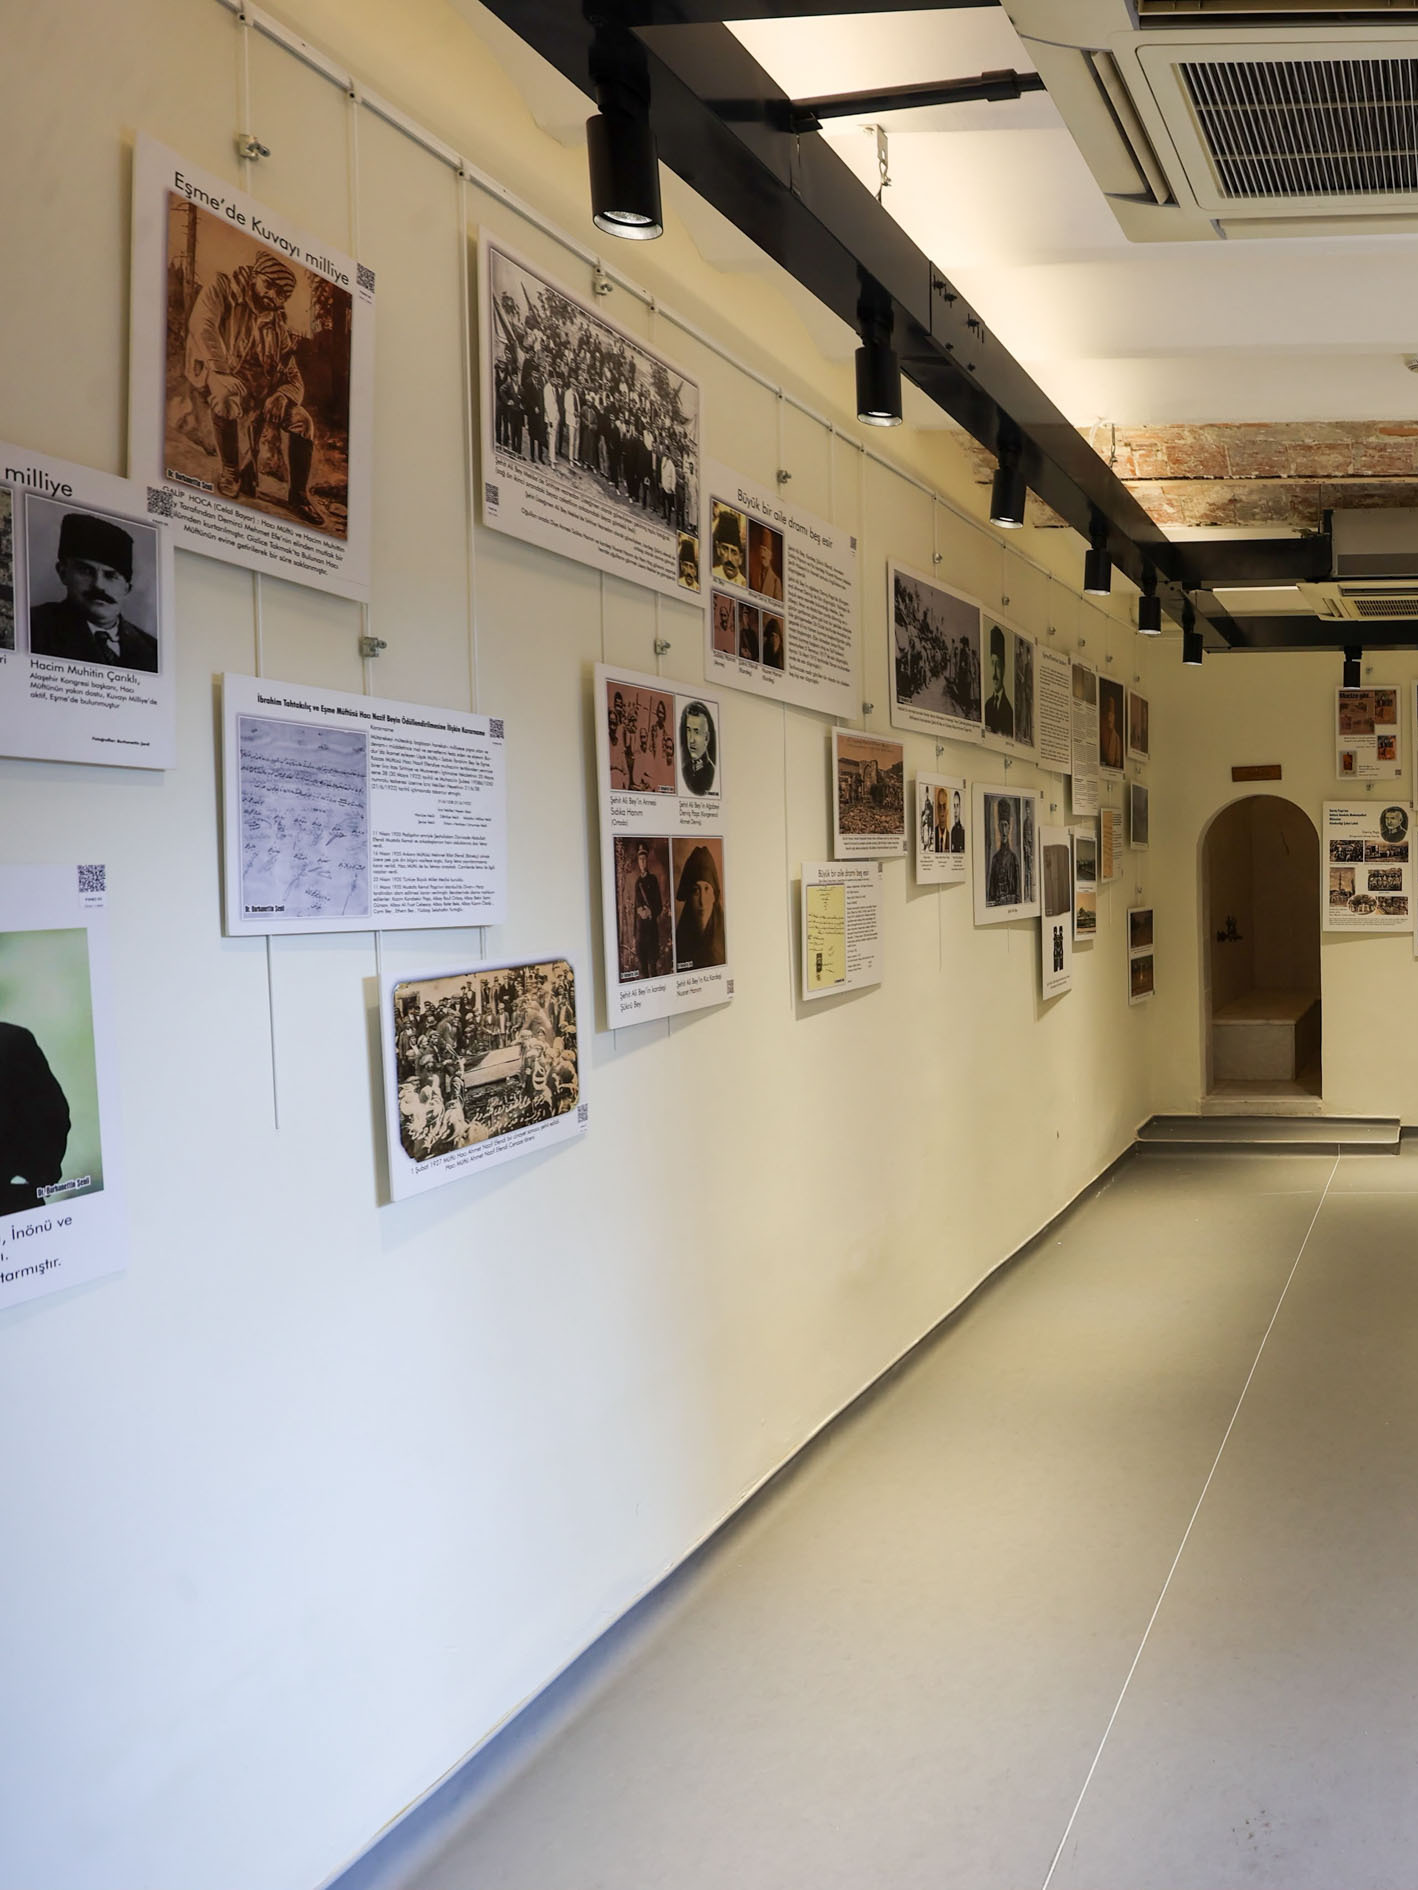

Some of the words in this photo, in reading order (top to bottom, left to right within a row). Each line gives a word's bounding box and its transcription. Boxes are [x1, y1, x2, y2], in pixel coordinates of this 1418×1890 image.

[174, 171, 246, 226] Eşme'de
[252, 216, 301, 258] Kuvayı
[305, 252, 350, 286] milliye
[5, 466, 73, 497] milliye
[188, 494, 212, 508] HOCA
[180, 501, 216, 520] Tarafından
[244, 521, 270, 537] Mehmet
[737, 488, 760, 511] Büyük
[762, 500, 772, 516] bir
[773, 510, 787, 525] aile
[809, 527, 821, 546] beş
[30, 659, 64, 673] Hacim
[30, 672, 58, 682] Alaşehir
[60, 677, 89, 687] Kongresi
[257, 692, 282, 706] İbrahim
[320, 704, 335, 715] Eşme
[12, 1219, 52, 1241] İnönü
[57, 1216, 73, 1226] ve
